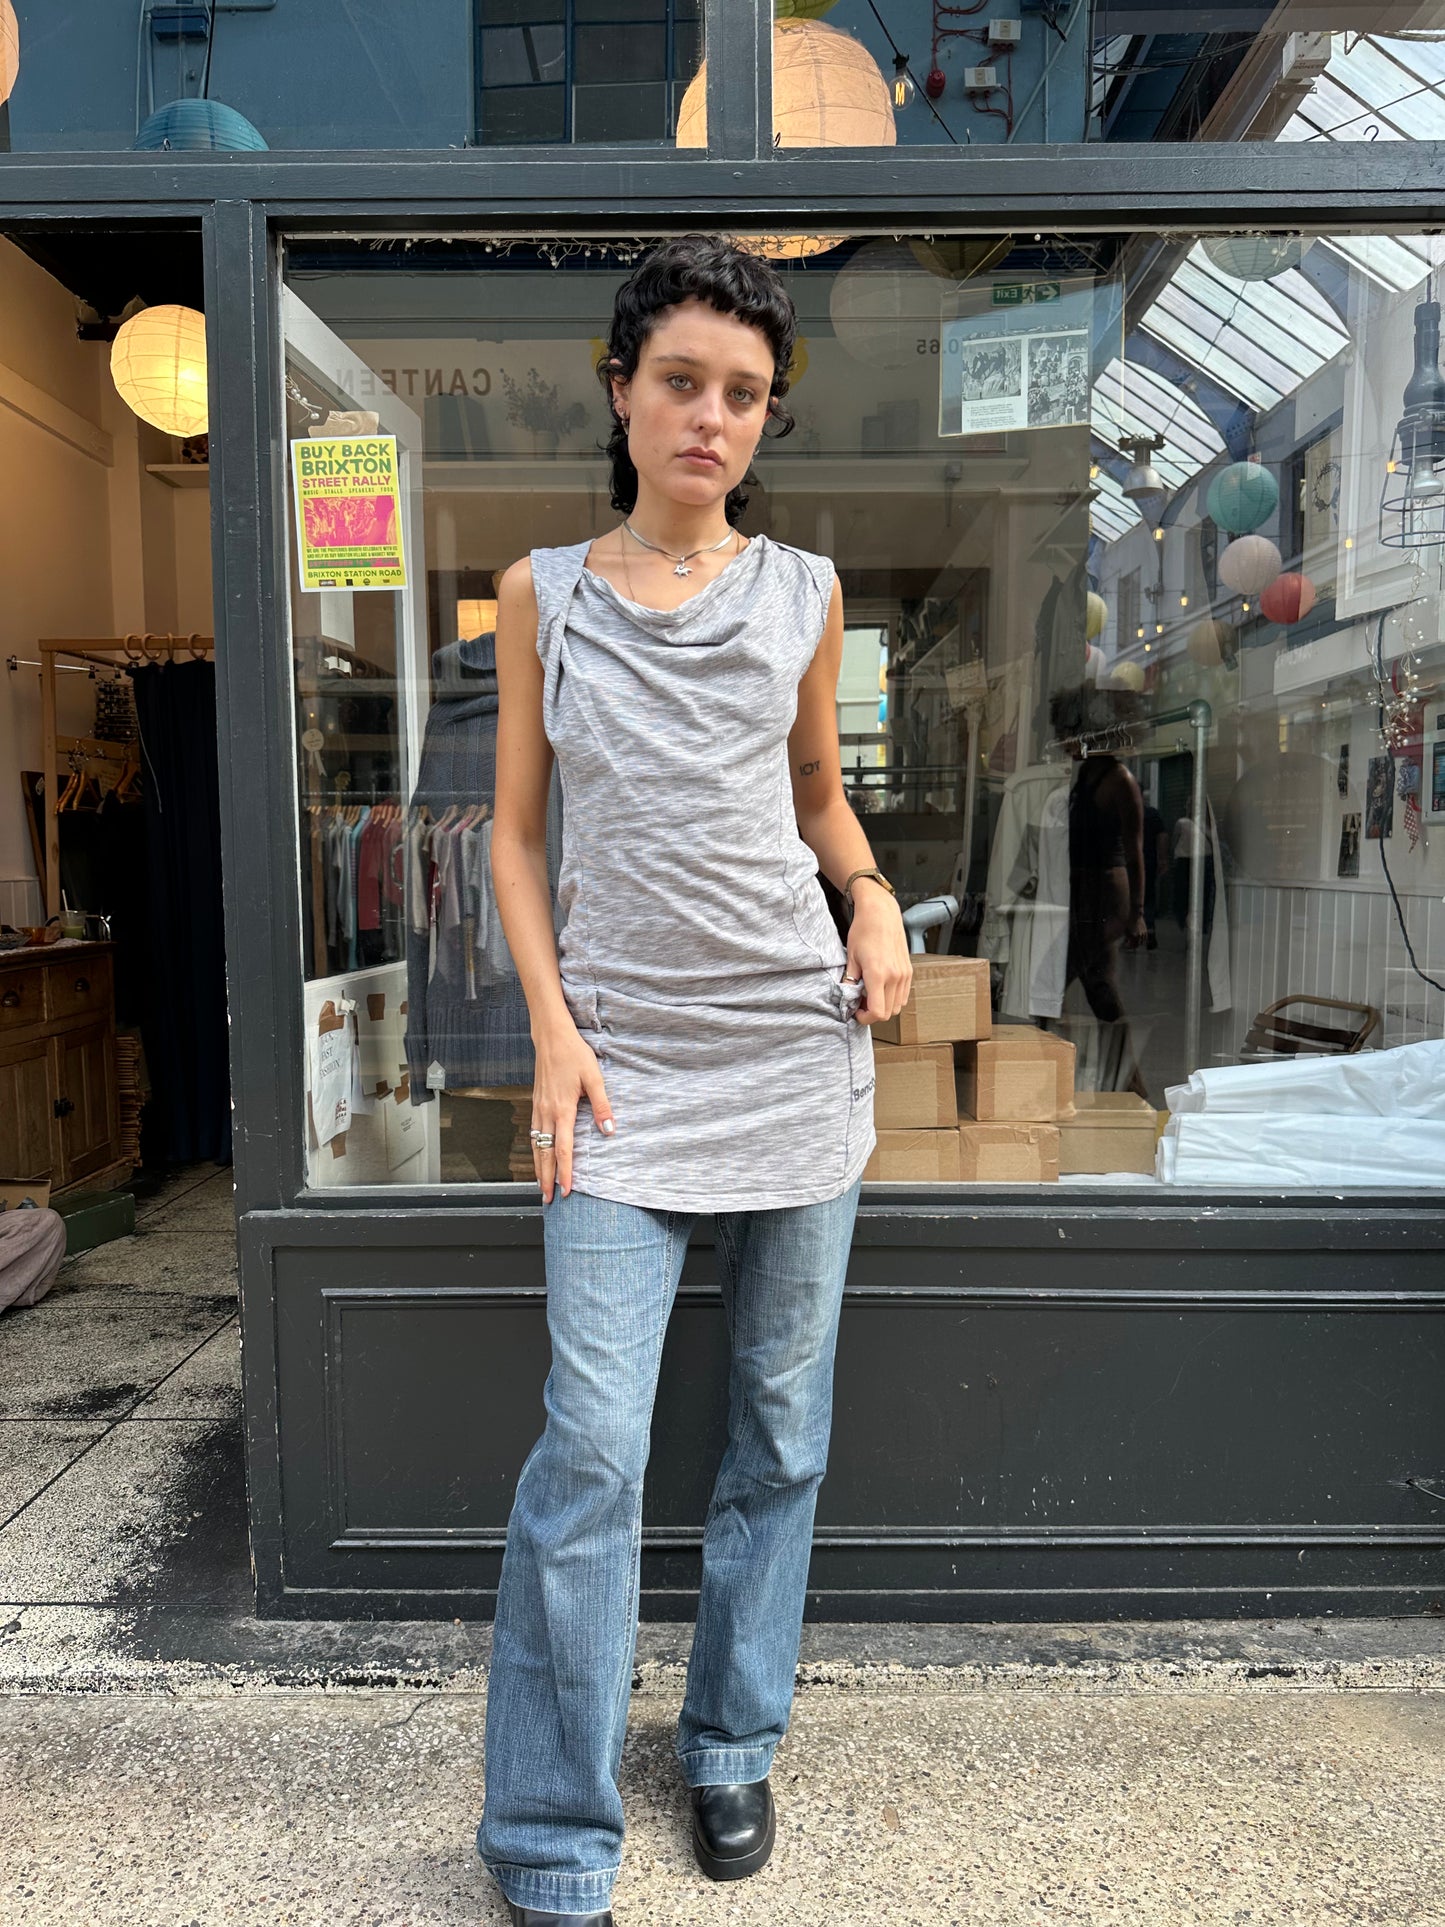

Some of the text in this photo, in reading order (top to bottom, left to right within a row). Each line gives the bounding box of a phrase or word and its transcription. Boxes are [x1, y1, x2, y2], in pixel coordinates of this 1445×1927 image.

[301, 443, 390, 459] BUY BACK
[302, 458, 391, 476] BRIXTON
[302, 475, 391, 488] STREET RALLY
[308, 570, 341, 578] BRIXTON
